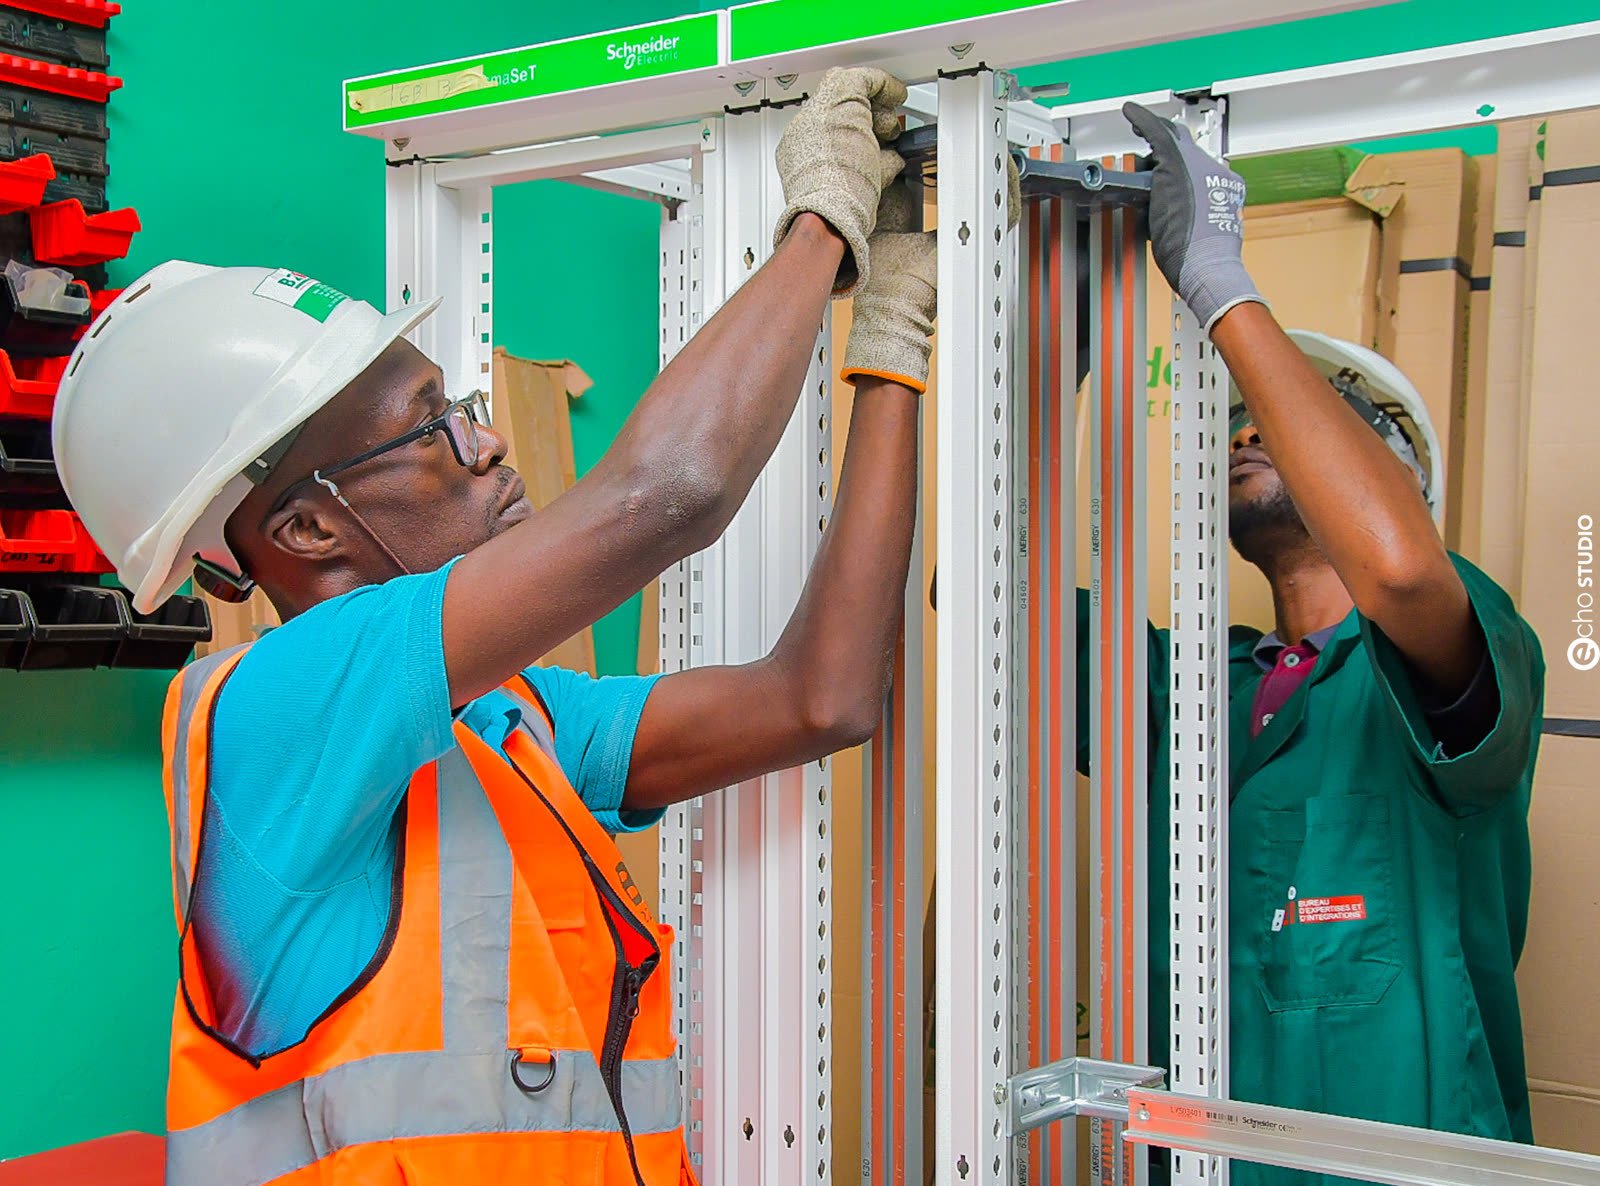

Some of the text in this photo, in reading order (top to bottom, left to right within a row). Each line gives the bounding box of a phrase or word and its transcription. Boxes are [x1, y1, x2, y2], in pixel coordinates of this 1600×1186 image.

[607, 35, 680, 60] Schneider
[637, 51, 678, 66] Electric
[486, 65, 537, 86] maSeT
[1020, 497, 1028, 515] 630
[1092, 498, 1100, 515] 630
[1092, 525, 1100, 557] LINERGY
[1298, 899, 1330, 907] BUREAU
[1352, 903, 1362, 911] ET
[1092, 1116, 1100, 1177] LINERGY 630
